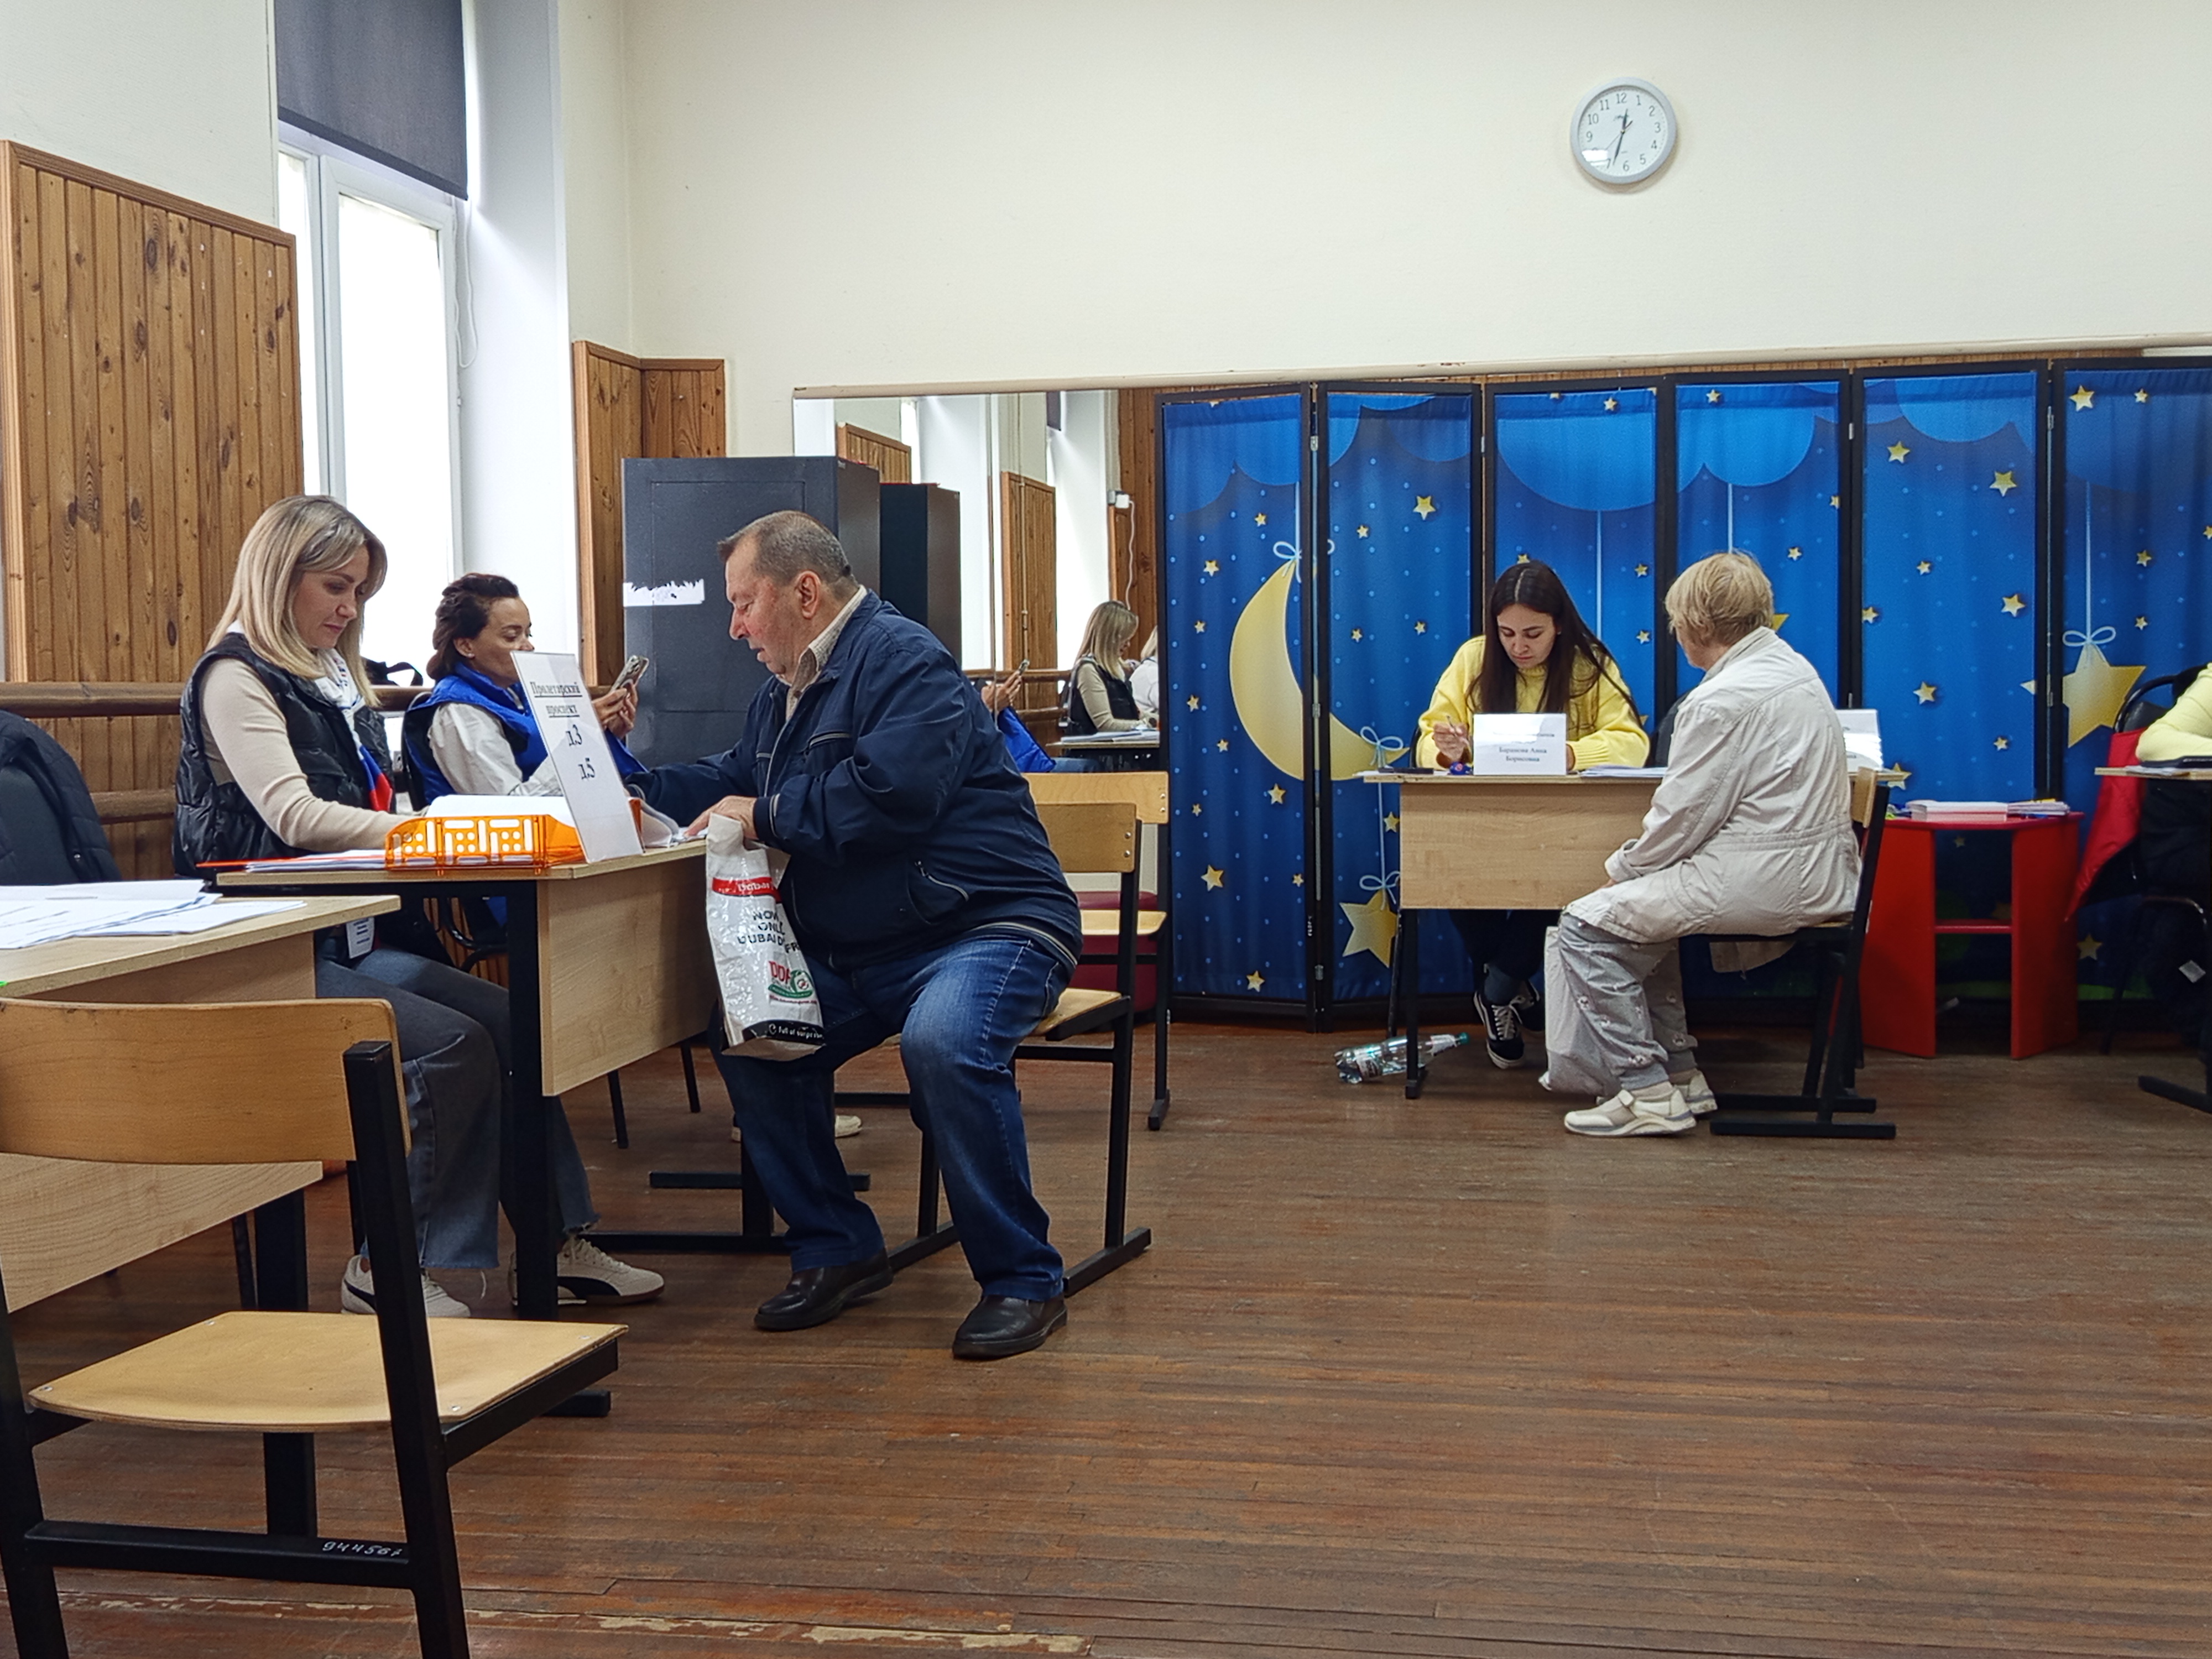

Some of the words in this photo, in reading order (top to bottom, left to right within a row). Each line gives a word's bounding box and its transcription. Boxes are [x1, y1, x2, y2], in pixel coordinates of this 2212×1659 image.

[1616, 92, 1627, 104] 12
[1636, 95, 1641, 106] 1
[1600, 99, 1610, 111] 11
[1648, 106, 1655, 117] 2
[1588, 113, 1599, 125] 10
[1655, 122, 1661, 133] 3
[1586, 131, 1593, 142] 9
[1651, 139, 1657, 149] 4
[1640, 153, 1646, 165] 5
[1623, 160, 1630, 171] 6
[545, 704, 577, 716] проспект
